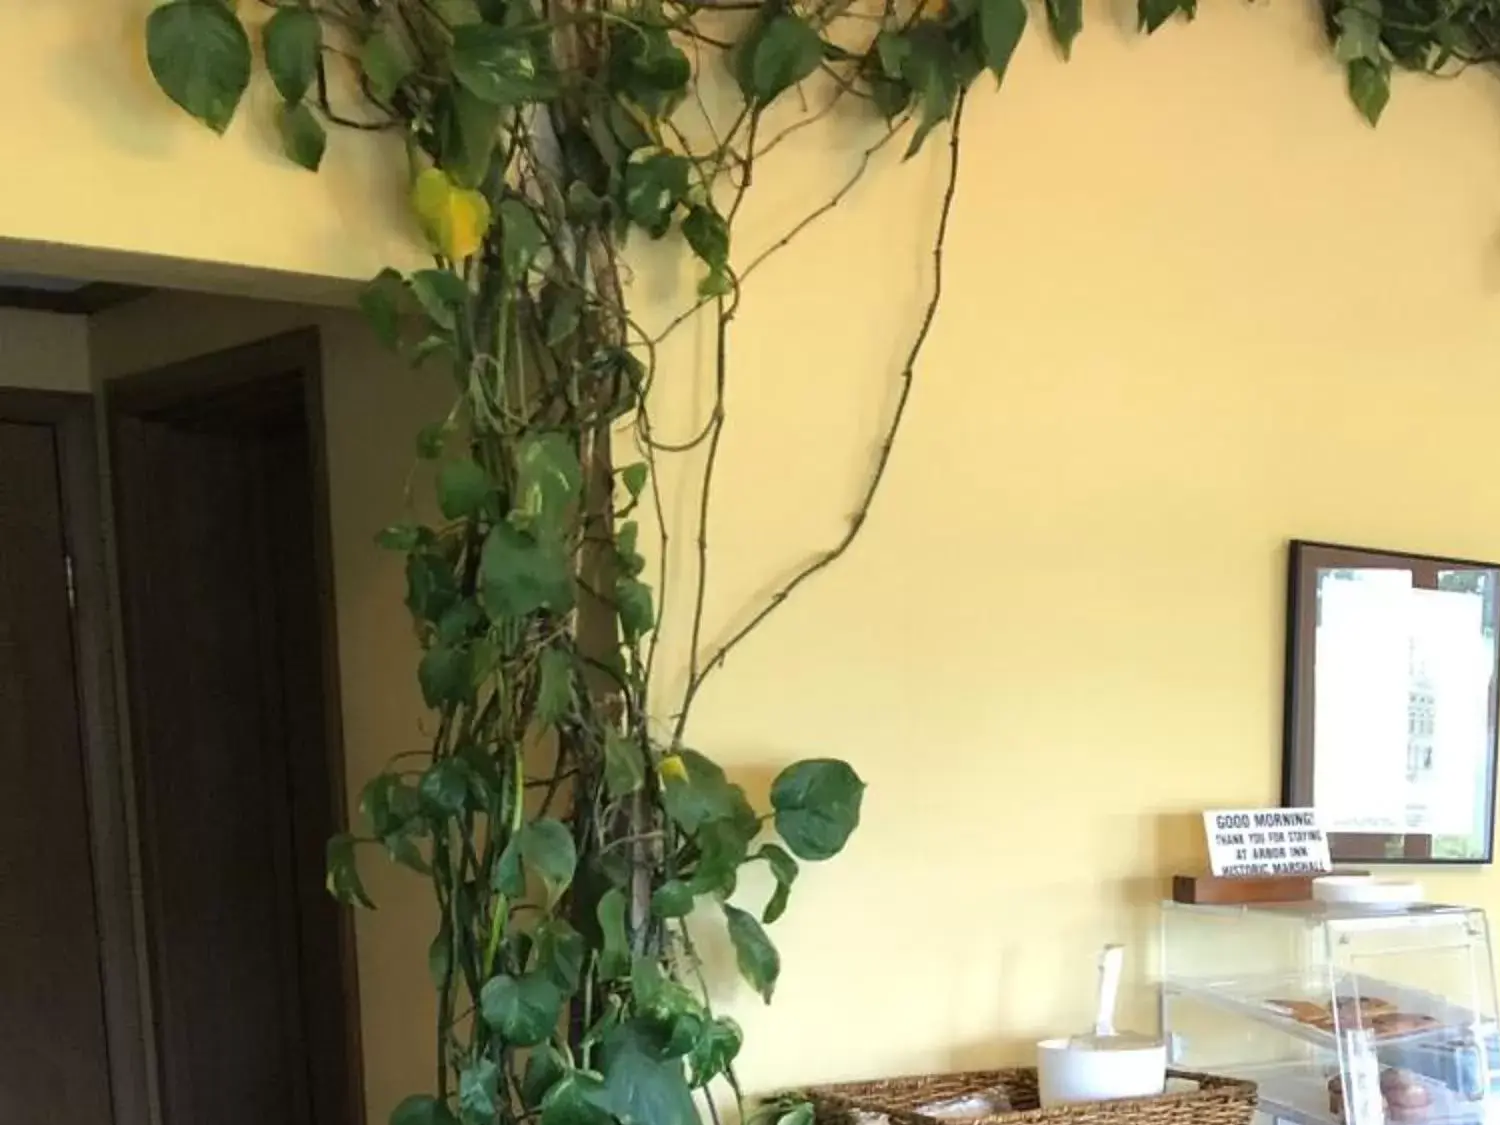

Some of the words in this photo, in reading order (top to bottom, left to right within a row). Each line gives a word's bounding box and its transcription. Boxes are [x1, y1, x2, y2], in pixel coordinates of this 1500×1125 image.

[1216, 814, 1250, 829] GOOD
[1216, 833, 1244, 845] THANK
[1247, 832, 1265, 844] YOU
[1268, 831, 1285, 842] FOR
[1288, 830, 1322, 842] STAYING
[1236, 848, 1247, 860] AT
[1253, 847, 1286, 859] ARBOR
[1222, 863, 1269, 876] HISTORIC
[1272, 860, 1325, 873] MARSHALL
